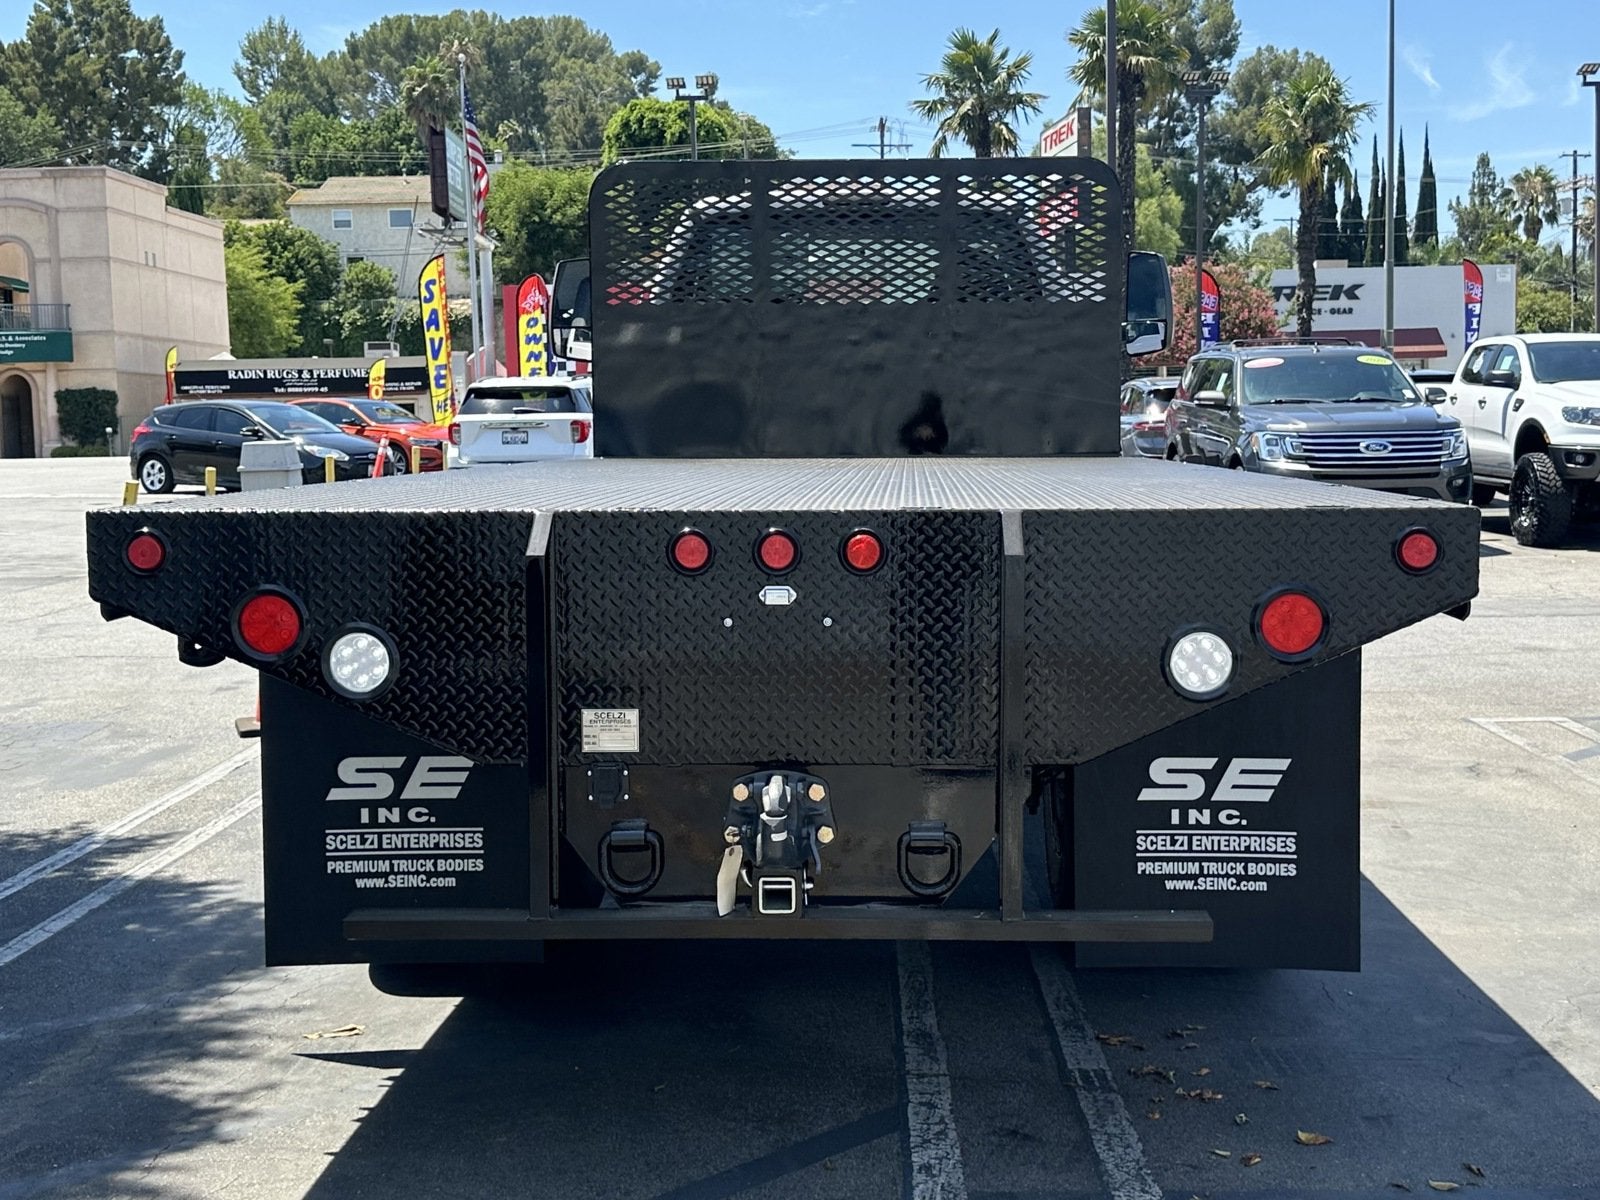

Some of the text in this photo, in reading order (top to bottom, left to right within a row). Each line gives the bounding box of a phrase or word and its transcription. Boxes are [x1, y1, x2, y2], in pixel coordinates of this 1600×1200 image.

[1043, 117, 1075, 153] TREK
[1329, 307, 1354, 315] GEAR
[423, 278, 447, 389] SAVE
[228, 370, 264, 379] RADIN
[266, 369, 299, 379] RUGS
[301, 368, 311, 379] &
[313, 367, 371, 378] PERFUME
[326, 756, 475, 801] SE
[1137, 757, 1292, 802] SE
[361, 807, 436, 824] INC.
[1171, 808, 1247, 826] INC.
[326, 833, 483, 850] SCELZI ENTERPRISES
[1136, 835, 1297, 852] SCELZI ENTERPRISES
[327, 859, 484, 873] PREMIUM TRUCK BODIES
[1137, 862, 1297, 876] PREMIUM TRUCK BODIES
[355, 875, 456, 888] www.SEINC.com
[1165, 877, 1268, 892] www.SEINC.com
